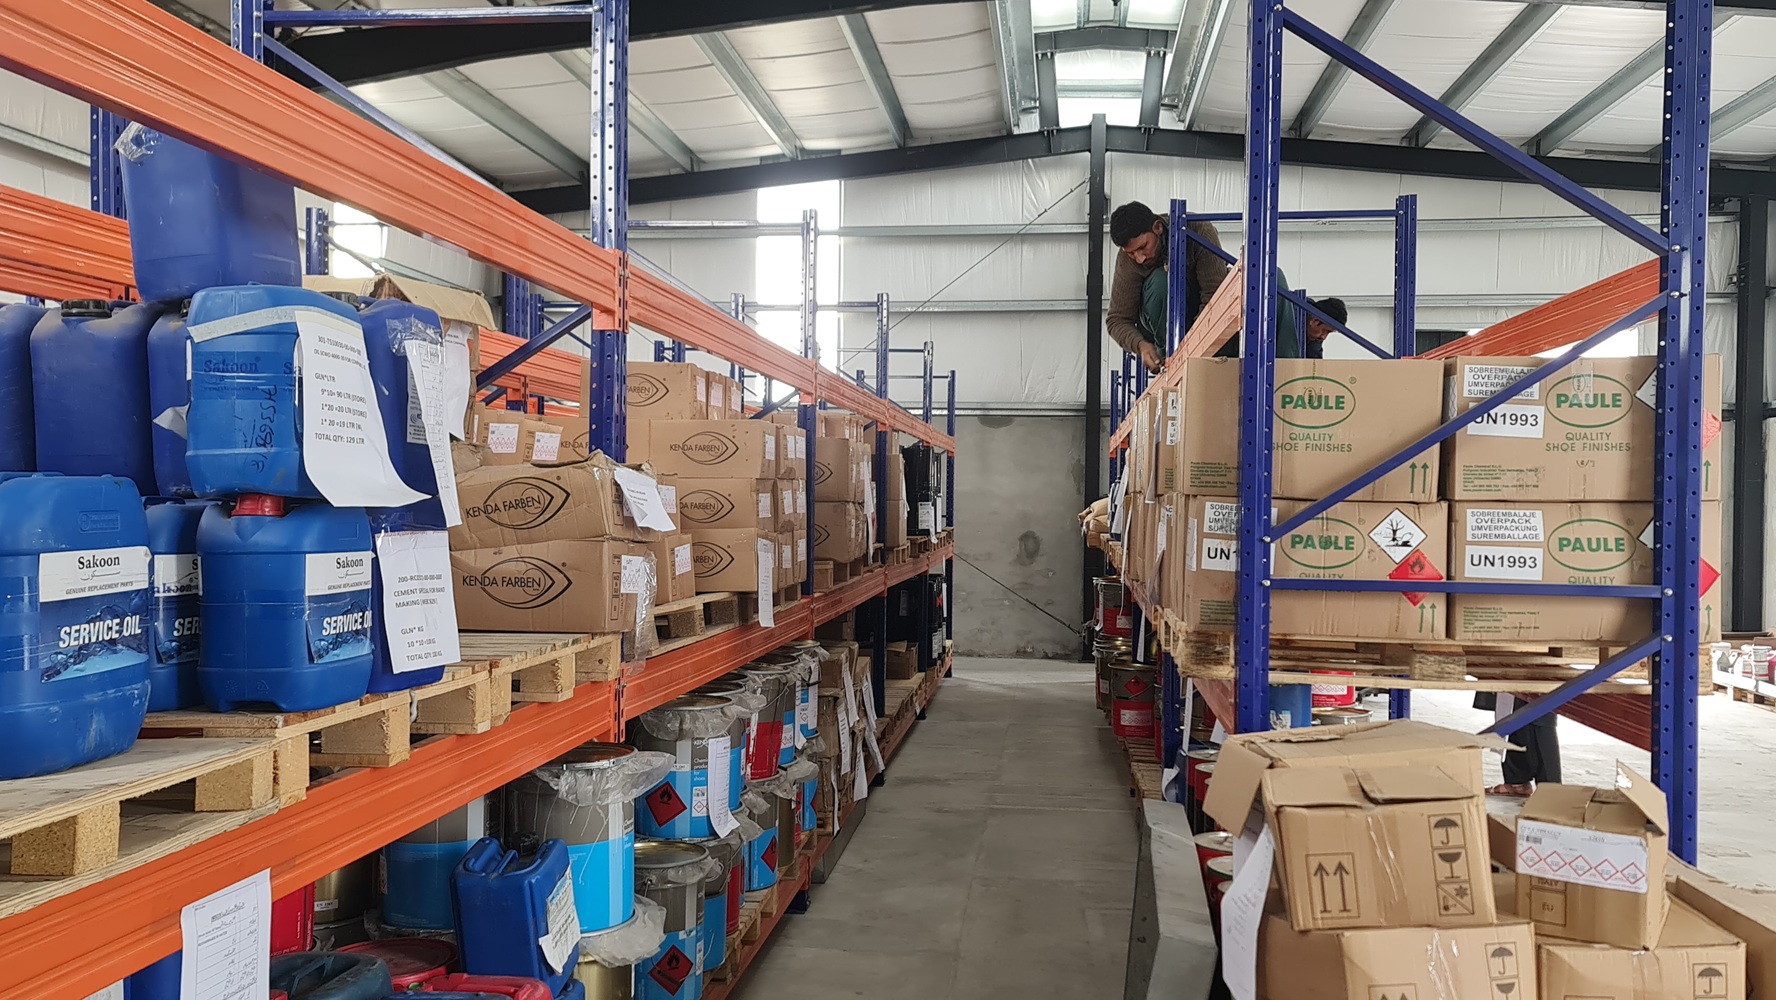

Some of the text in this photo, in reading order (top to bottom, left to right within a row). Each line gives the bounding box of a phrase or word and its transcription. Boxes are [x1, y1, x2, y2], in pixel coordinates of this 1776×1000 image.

[1281, 394, 1346, 410] PAULE
[1556, 393, 1622, 408] PAULE
[314, 432, 332, 442] TOTAL
[1288, 432, 1334, 442] QUALITY
[1565, 432, 1612, 441] QUALITY
[560, 438, 584, 449] KENDA
[670, 444, 720, 452] KENDA FARBEN
[1304, 443, 1353, 452] FINISHES
[1545, 442, 1632, 452] SHOE FINISHES
[466, 495, 542, 519] KENDA FARBEN
[690, 502, 716, 510] FARBEN
[1470, 510, 1536, 518] SOBREEMBALAJE
[1470, 524, 1538, 532] UMVERPACKUNG
[1290, 534, 1355, 550] PAULE
[1558, 537, 1625, 552] PAULE
[78, 554, 120, 570] Sakoon
[336, 556, 364, 570] Sakoon
[1470, 554, 1538, 569] UN1993
[462, 575, 541, 588] KENDA FARBEN
[1568, 576, 1616, 584] QUALITY
[66, 580, 134, 594] GENUINE REPLACEMENT PARTS
[394, 588, 418, 598] CEMENT
[395, 598, 420, 608] MAKING
[322, 610, 372, 636] SERVICE OI
[58, 618, 120, 648] SERVICE
[122, 614, 142, 637] OIL
[406, 654, 424, 662] TOTAL
